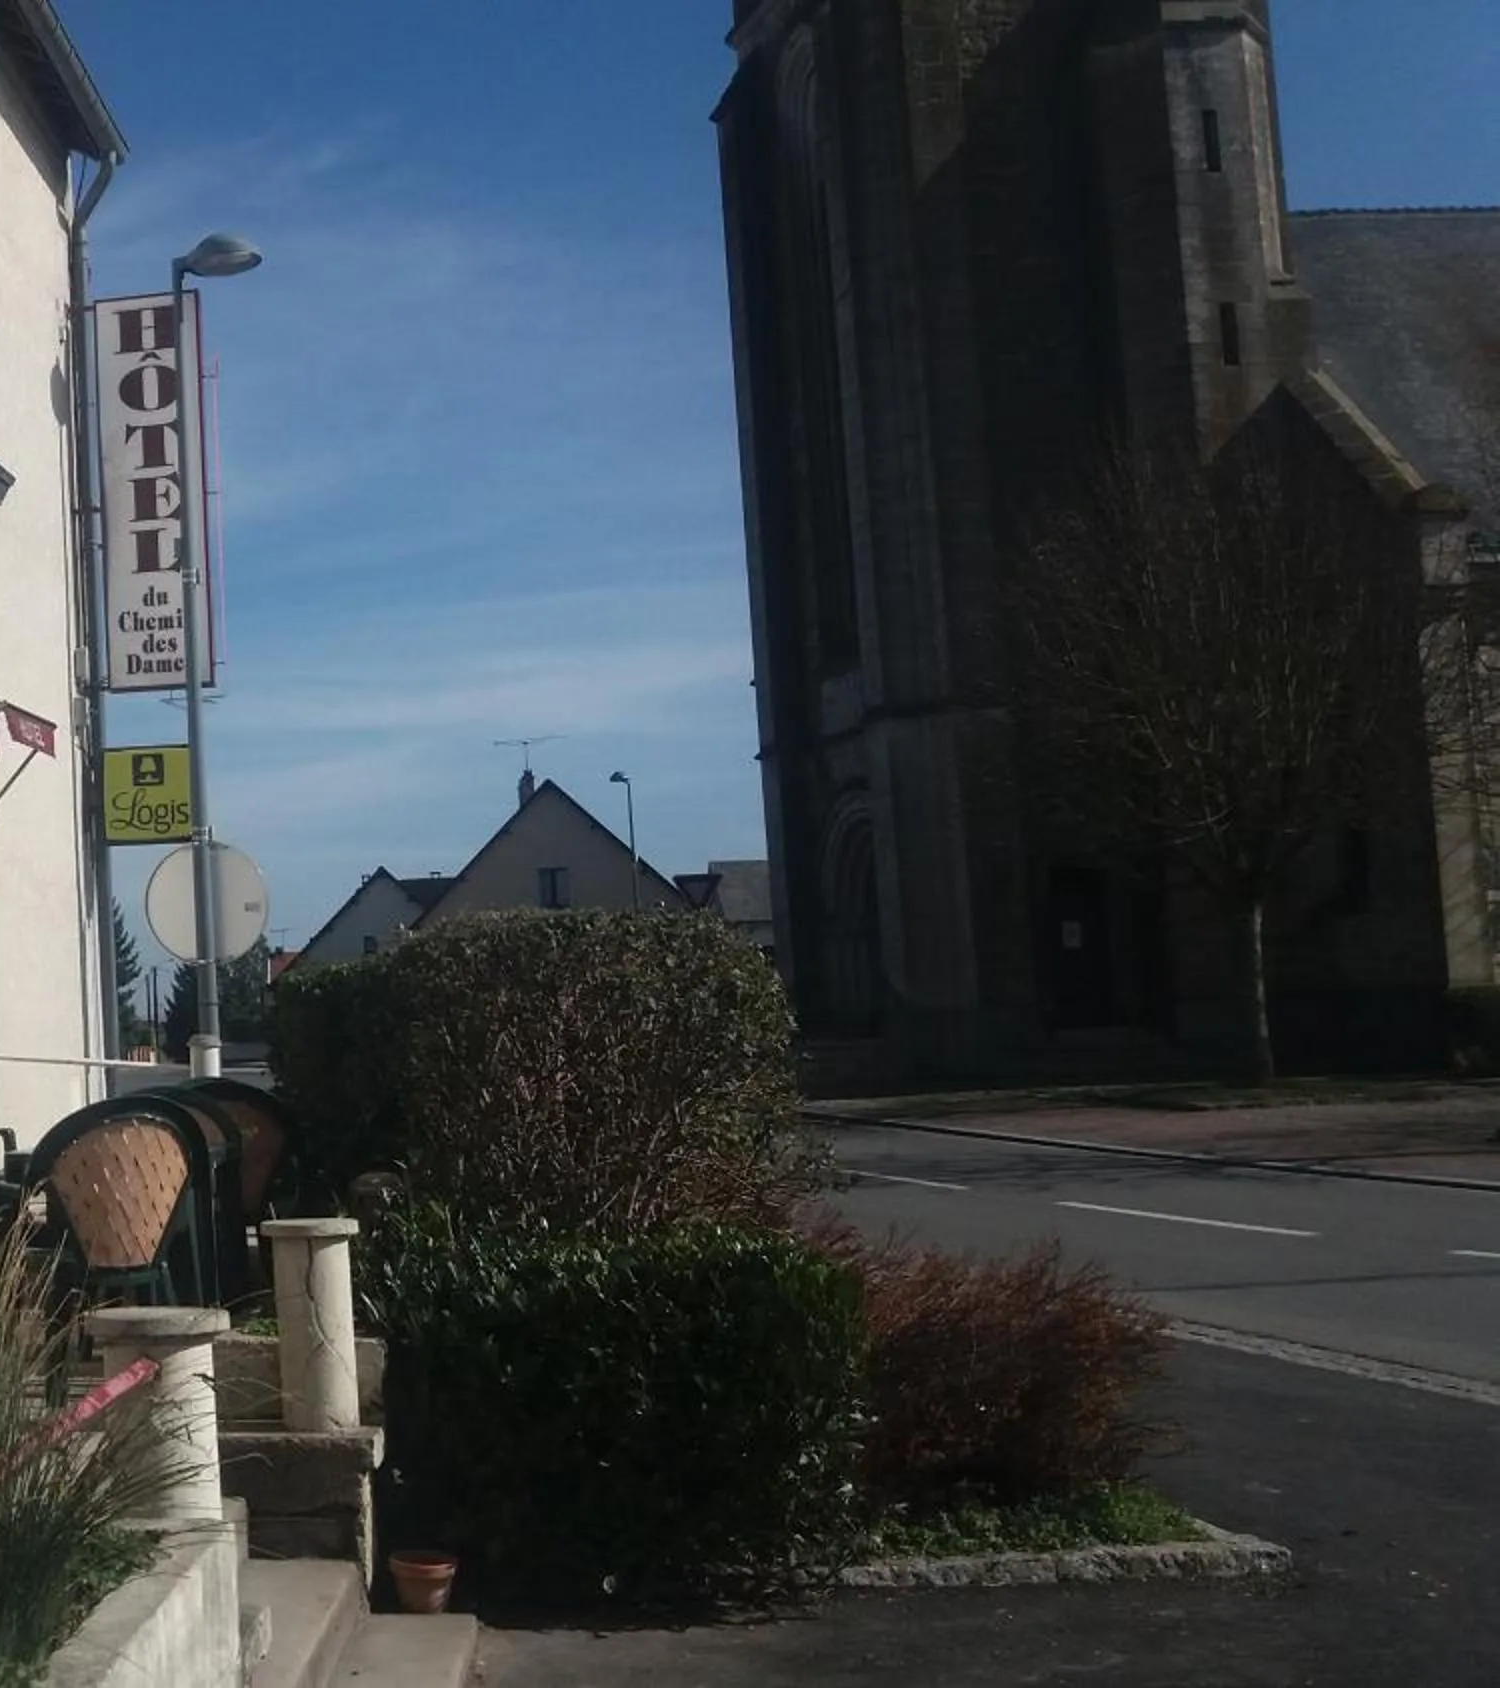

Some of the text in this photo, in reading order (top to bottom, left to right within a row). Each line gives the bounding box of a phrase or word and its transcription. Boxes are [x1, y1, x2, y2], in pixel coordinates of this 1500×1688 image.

[142, 586, 169, 607] du
[117, 608, 184, 632] Chemi
[142, 633, 178, 654] des
[125, 653, 185, 675] Dame
[110, 788, 190, 835] Logis
